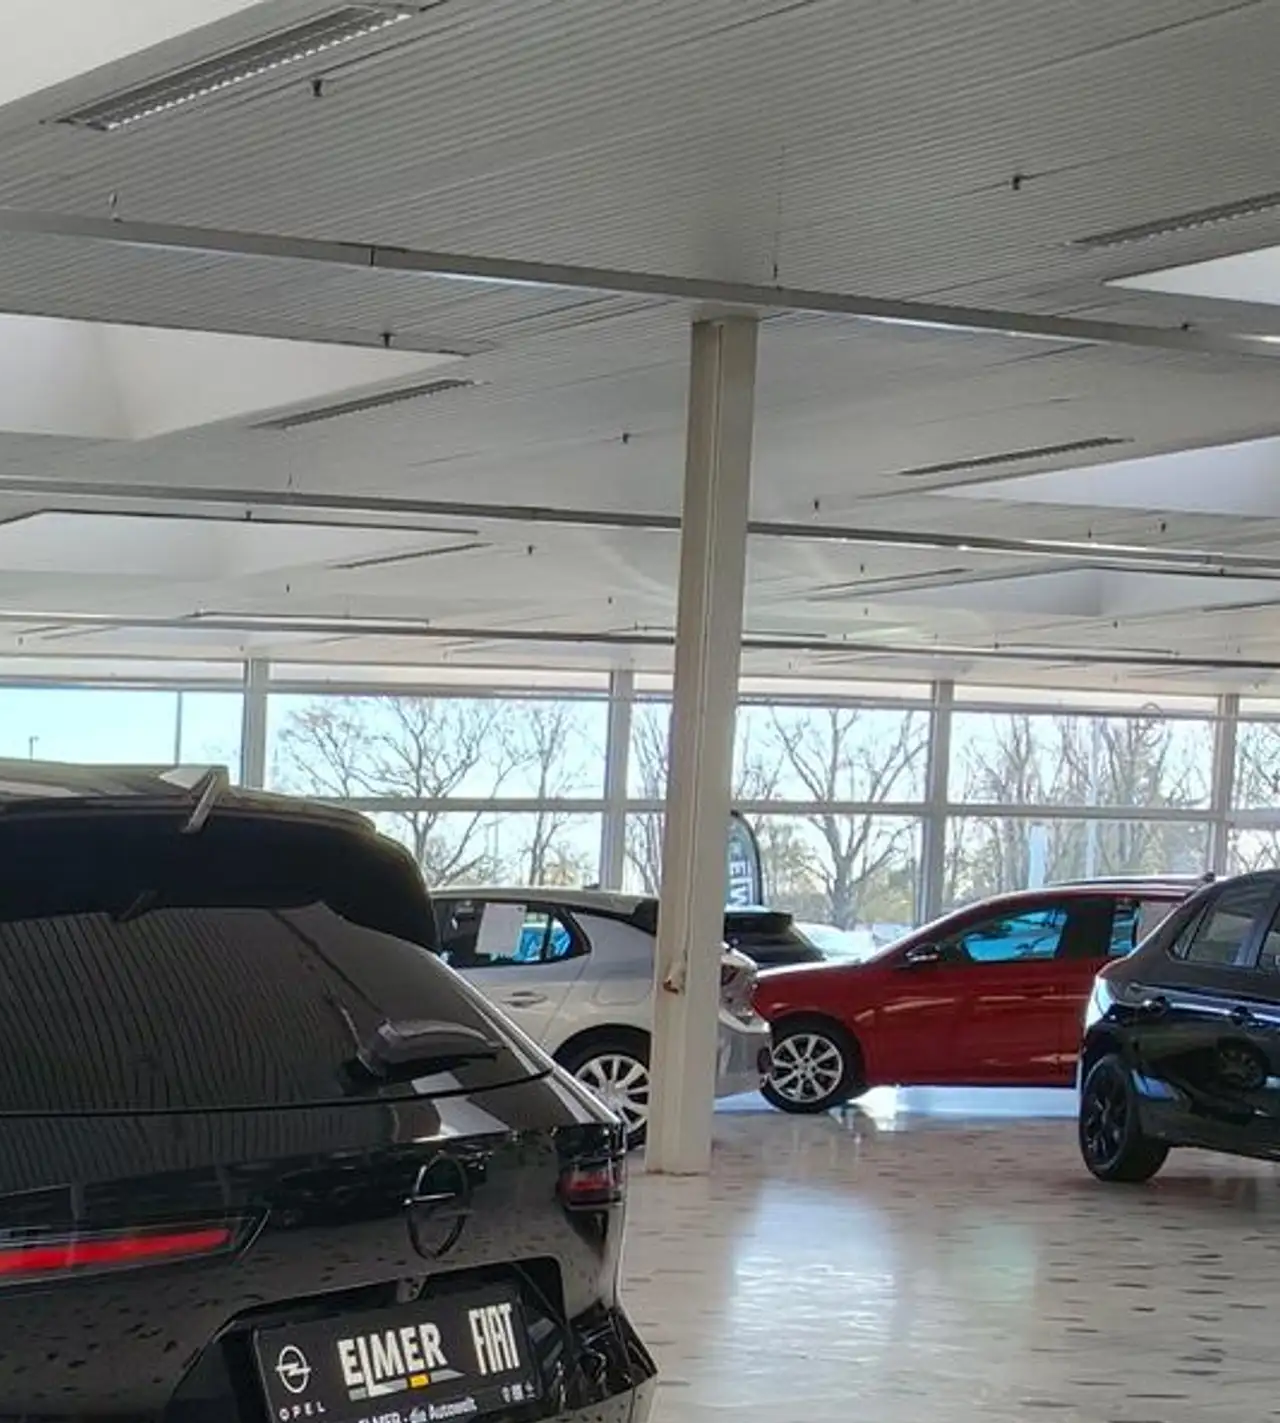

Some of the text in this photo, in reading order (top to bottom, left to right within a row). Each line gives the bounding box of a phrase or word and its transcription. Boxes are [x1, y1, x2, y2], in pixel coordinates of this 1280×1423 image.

[337, 1322, 448, 1398] ELMER
[468, 1302, 520, 1376] FIAT
[279, 1400, 327, 1422] OPEL
